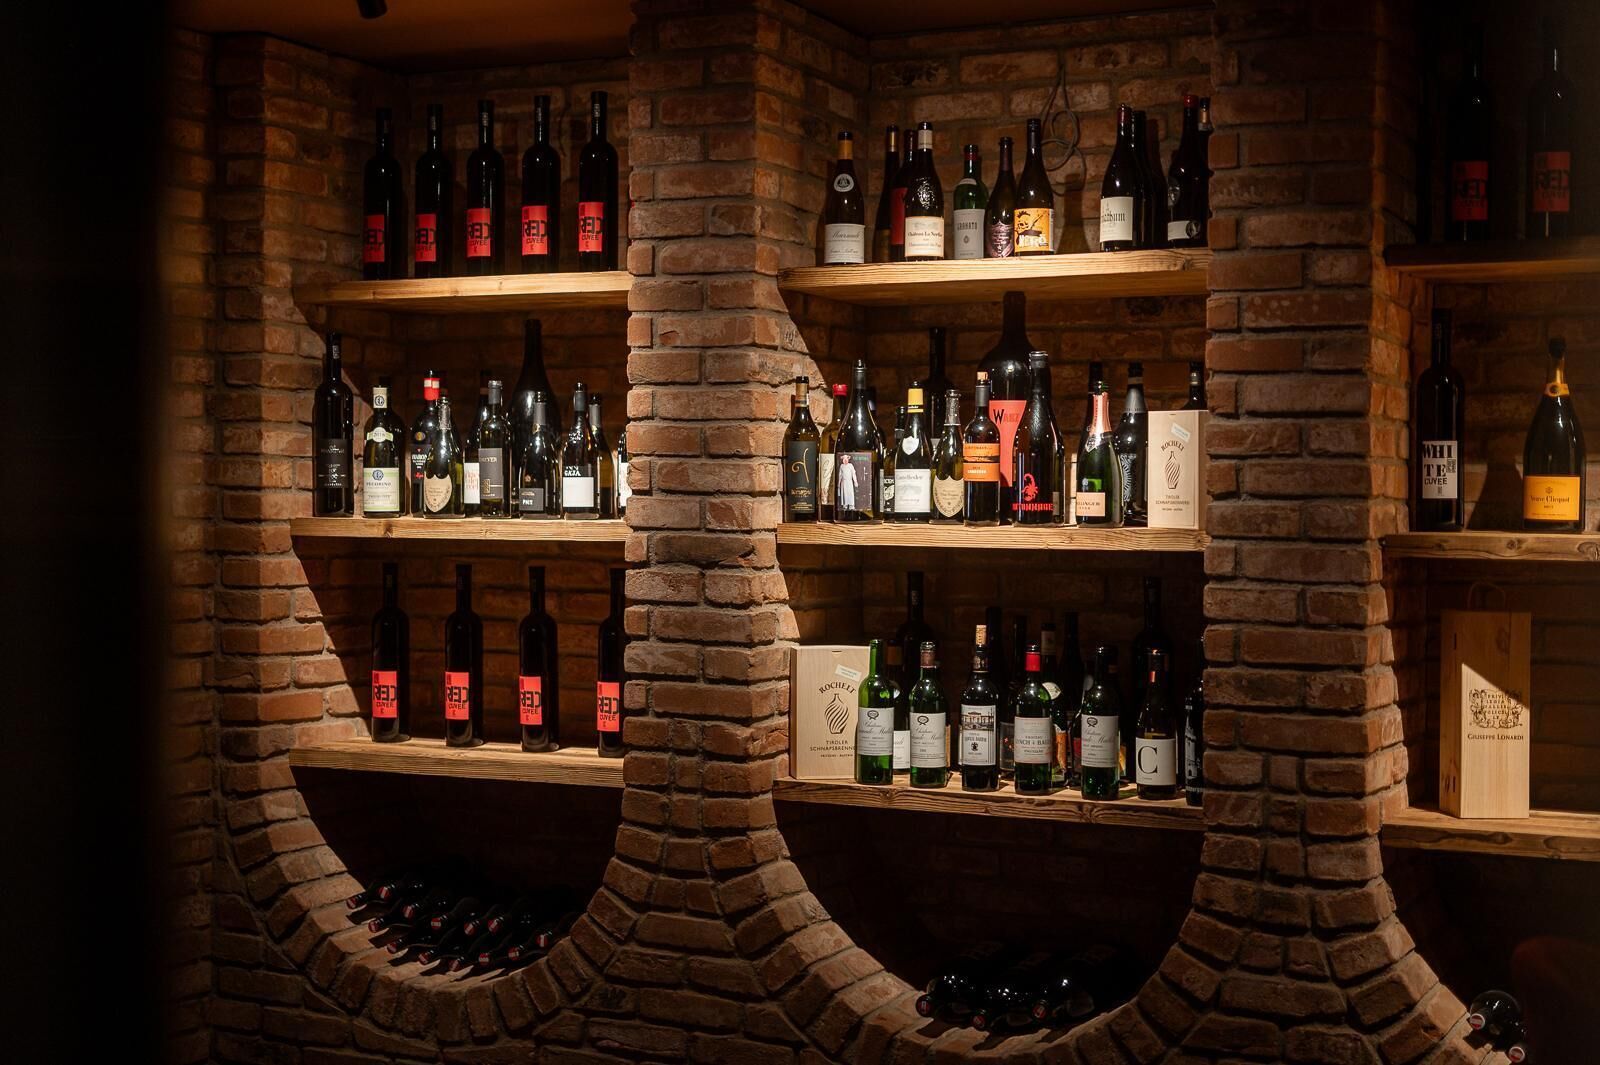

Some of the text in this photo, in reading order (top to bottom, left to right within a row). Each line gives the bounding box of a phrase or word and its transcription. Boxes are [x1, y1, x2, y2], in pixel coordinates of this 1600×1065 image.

[467, 222, 491, 240] RED
[523, 220, 548, 236] RED
[580, 216, 604, 234] RED
[373, 684, 398, 702] RED
[447, 685, 470, 704] RED
[818, 681, 856, 694] ROCHELT
[520, 690, 542, 708] RED
[598, 696, 620, 715] RED
[1137, 745, 1158, 774] C
